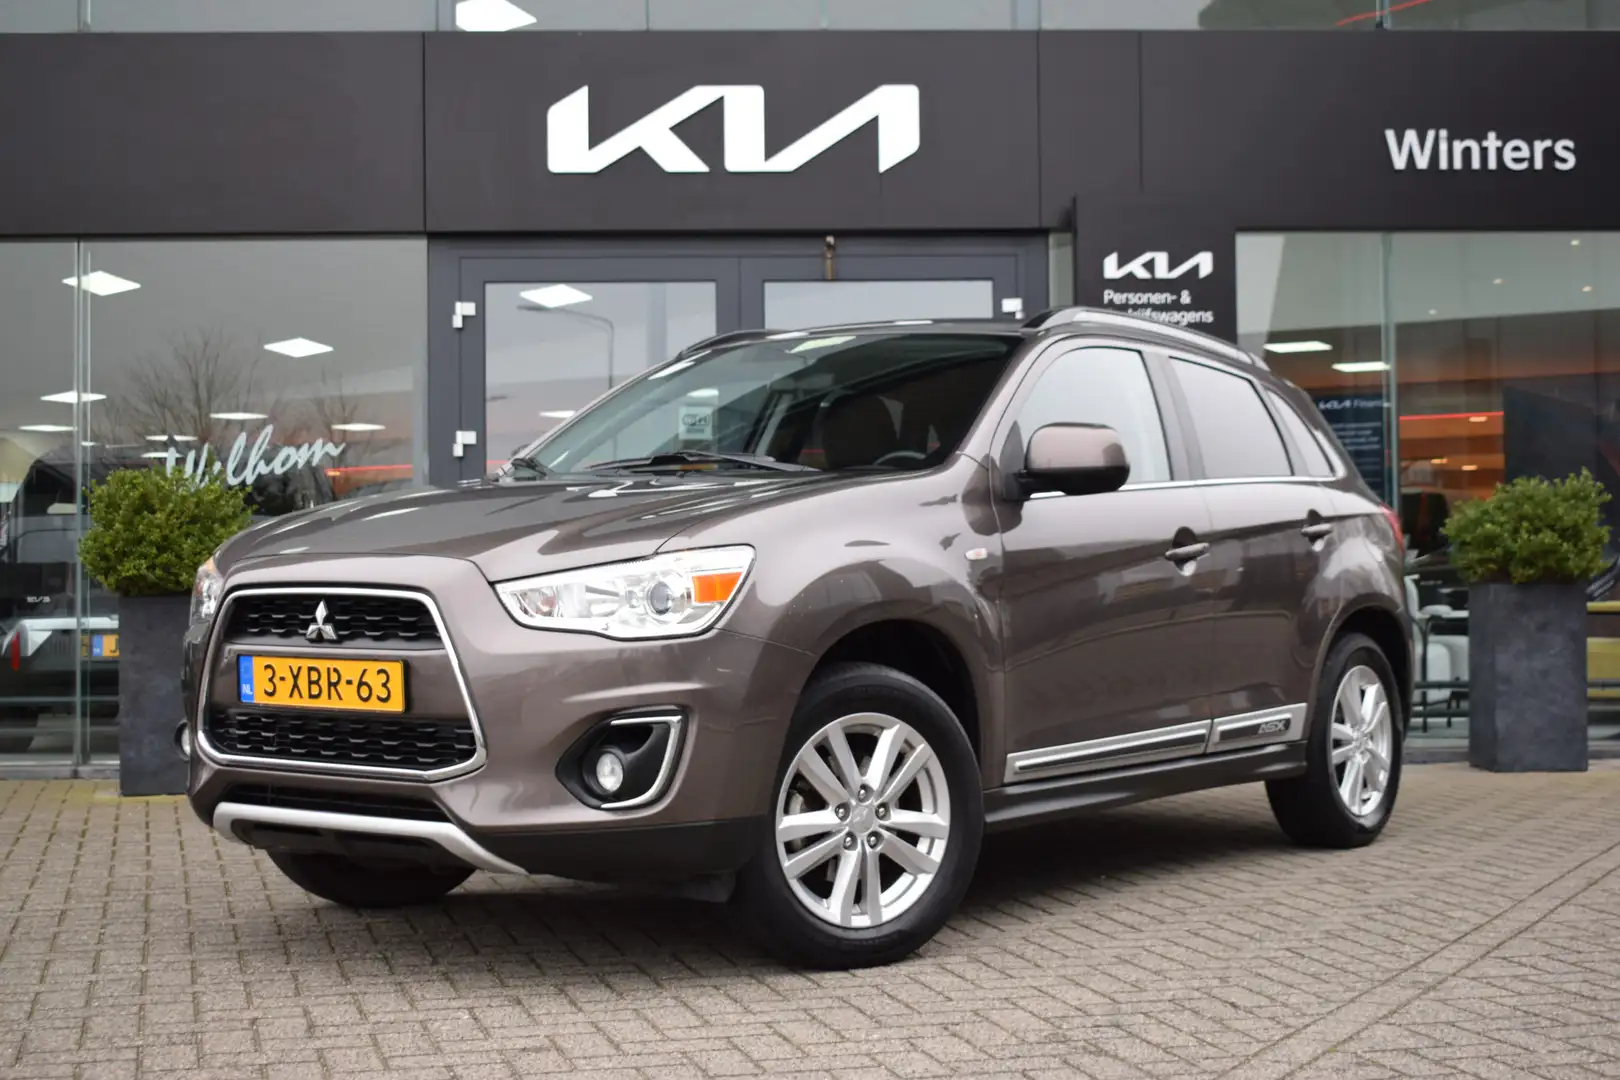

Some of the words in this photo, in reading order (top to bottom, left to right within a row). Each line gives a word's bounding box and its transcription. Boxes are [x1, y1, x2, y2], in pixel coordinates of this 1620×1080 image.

[547, 84, 920, 174] KIA
[1384, 128, 1577, 171] Winters
[1103, 251, 1213, 279] KIA
[1103, 289, 1178, 304] Personen-
[1180, 289, 1192, 304] &
[263, 663, 391, 703] 3-XBR-63
